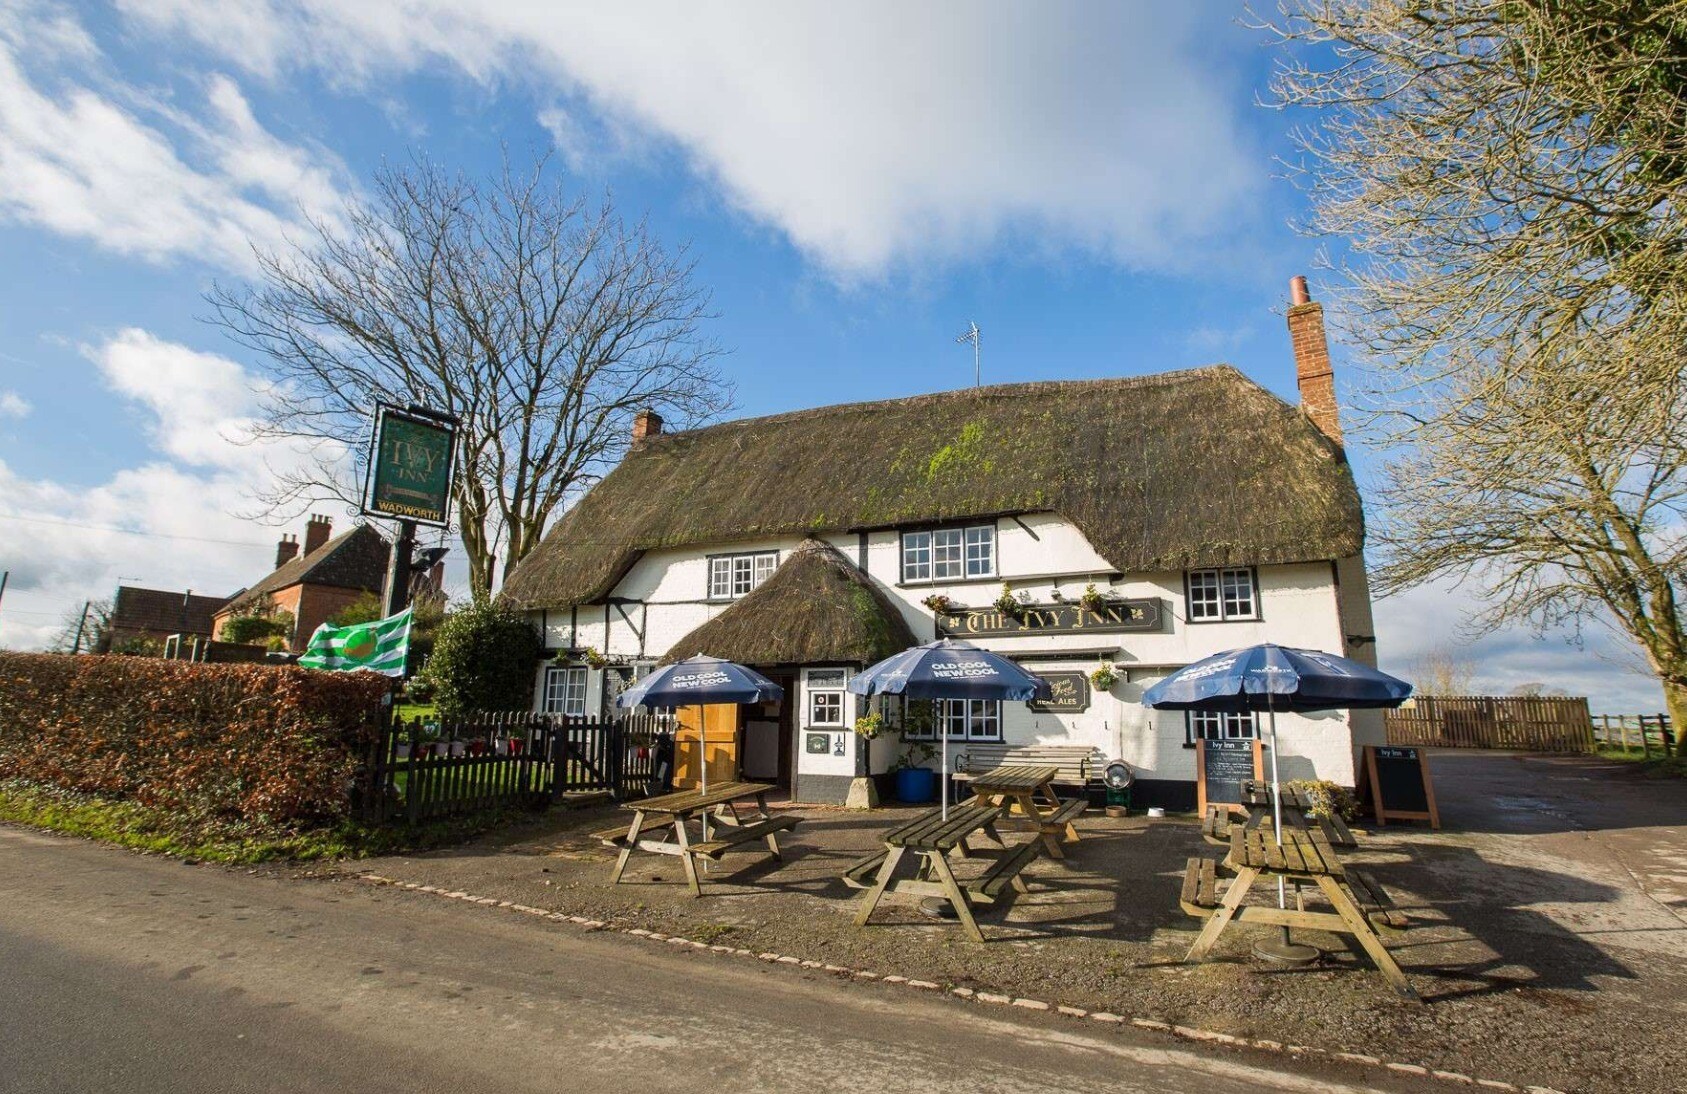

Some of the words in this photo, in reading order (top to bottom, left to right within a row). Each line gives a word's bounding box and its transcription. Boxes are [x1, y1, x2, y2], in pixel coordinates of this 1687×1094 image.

[389, 438, 440, 473] IVY
[397, 469, 428, 483] INN
[378, 501, 441, 521] WADWORTH
[697, 672, 727, 680] COOL
[933, 669, 963, 678] NEW
[673, 680, 700, 688] NEW
[701, 677, 731, 685] COOL
[1058, 697, 1077, 705] ALES
[1212, 741, 1222, 749] Ivy
